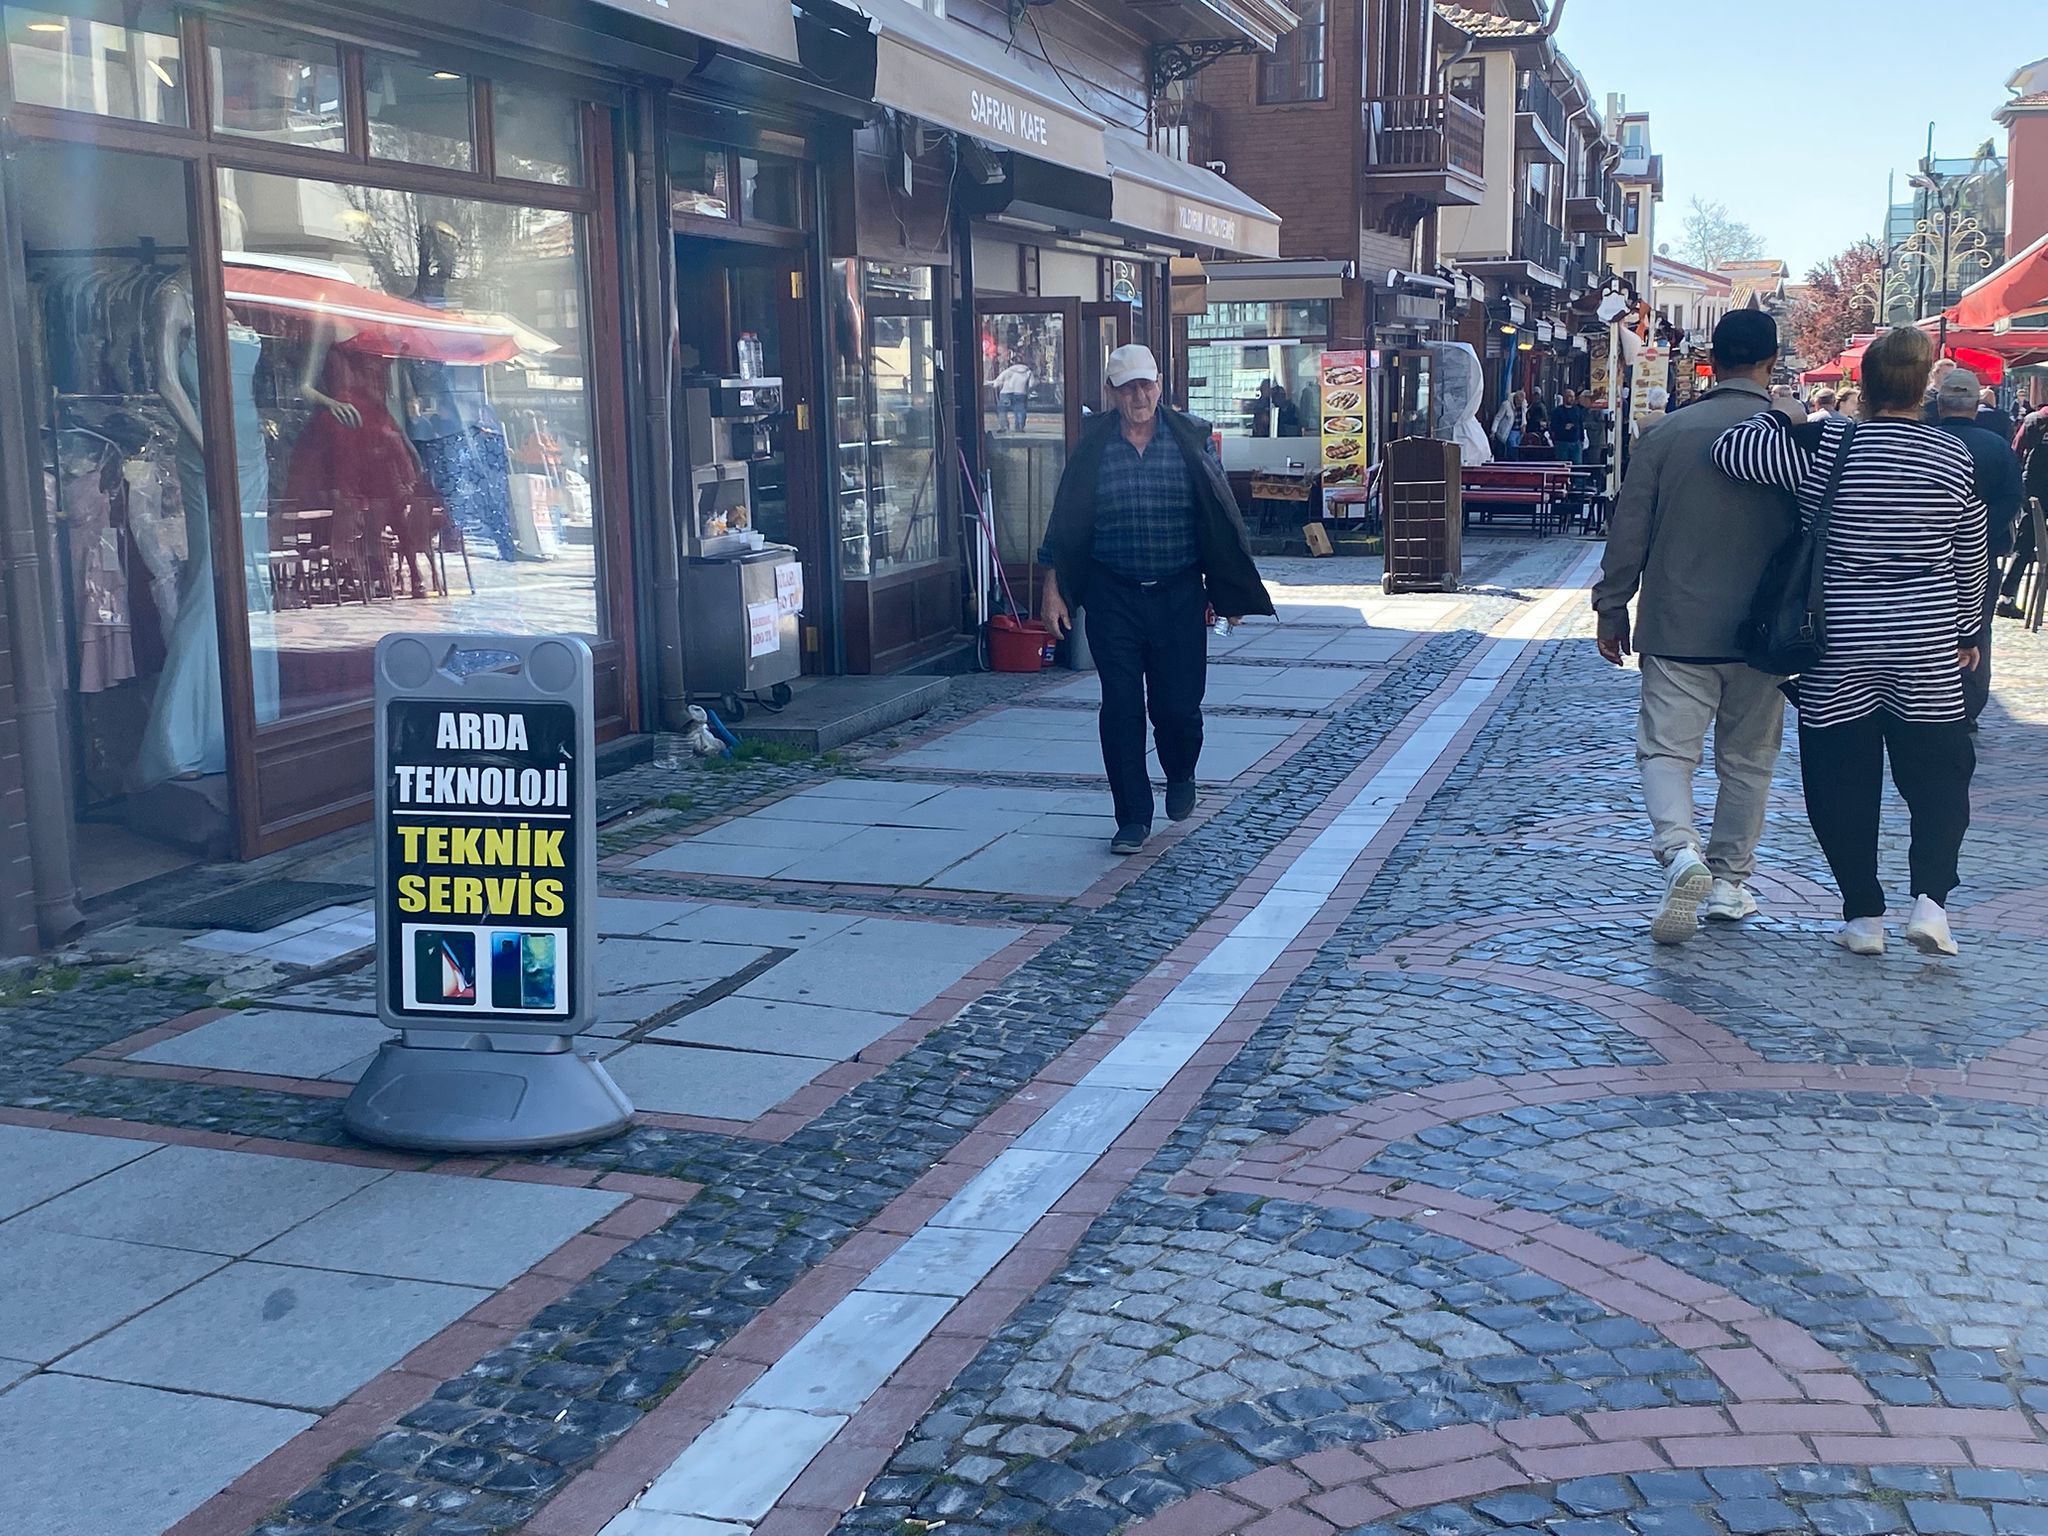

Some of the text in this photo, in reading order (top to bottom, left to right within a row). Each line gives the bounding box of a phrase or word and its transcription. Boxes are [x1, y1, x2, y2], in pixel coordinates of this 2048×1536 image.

[971, 89, 1048, 146] SAFRAN KAFE
[436, 712, 529, 751] ARDA
[394, 763, 568, 807] TEKNOLOJİ
[397, 822, 565, 867] TEKNİK
[397, 872, 565, 917] SERVİS
